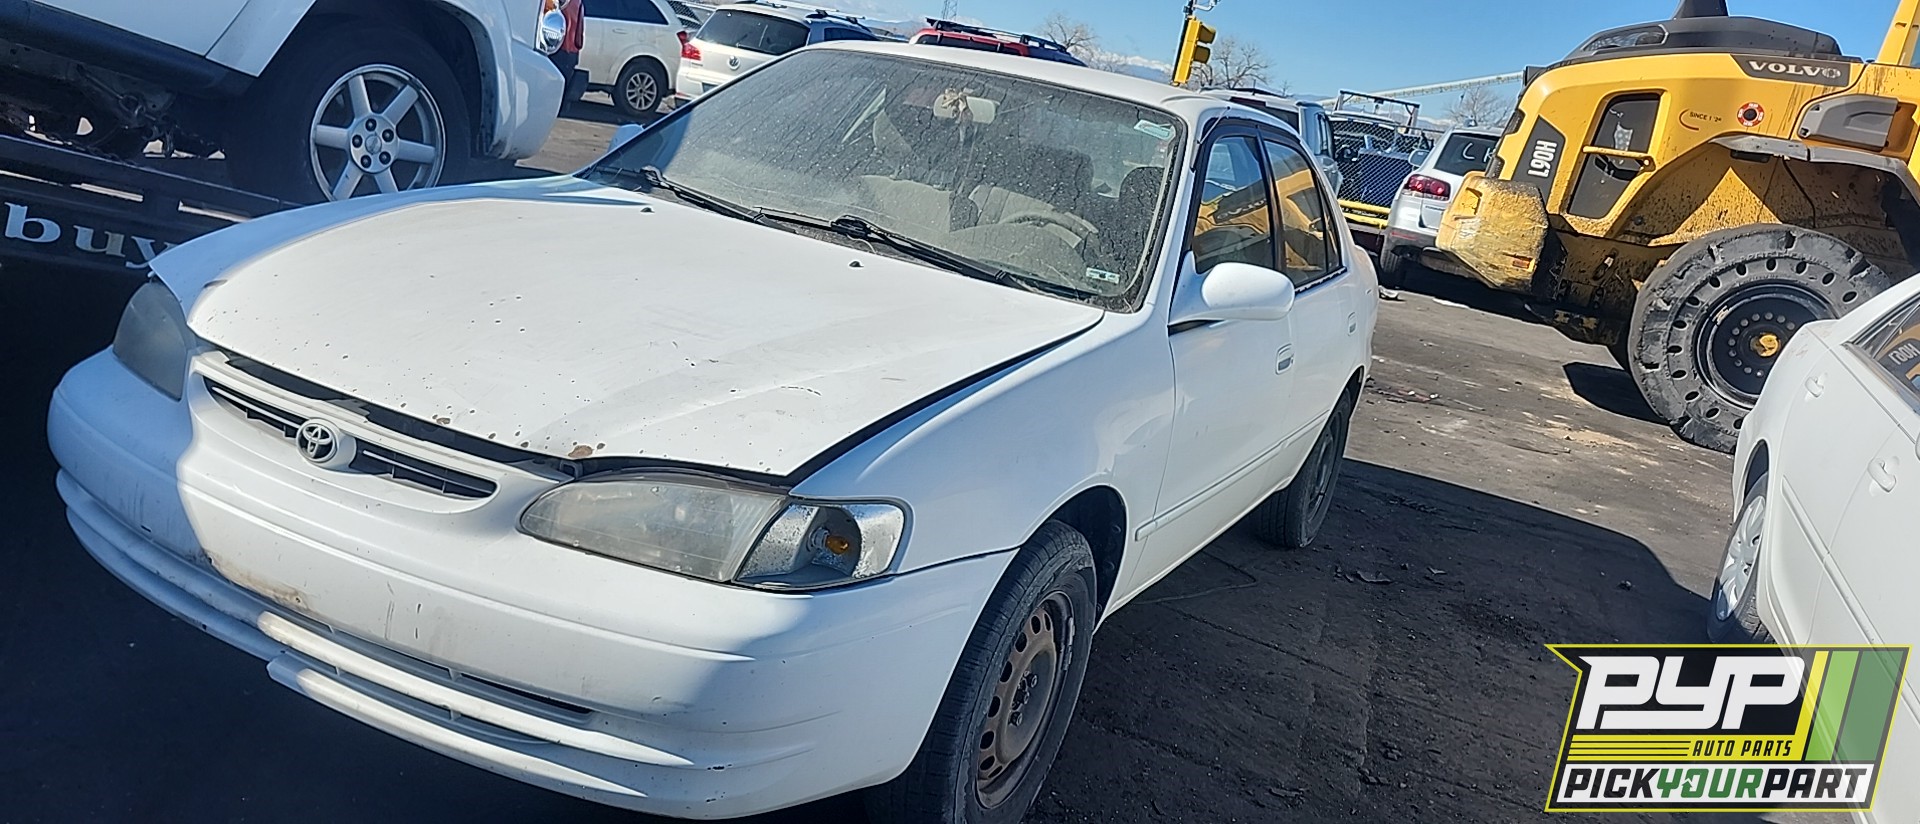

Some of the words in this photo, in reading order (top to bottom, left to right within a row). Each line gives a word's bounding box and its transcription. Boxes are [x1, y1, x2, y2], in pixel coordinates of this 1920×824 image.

[1749, 60, 1841, 79] VOLVO
[1689, 111, 1708, 121] SINCE
[4, 202, 178, 269] buy
